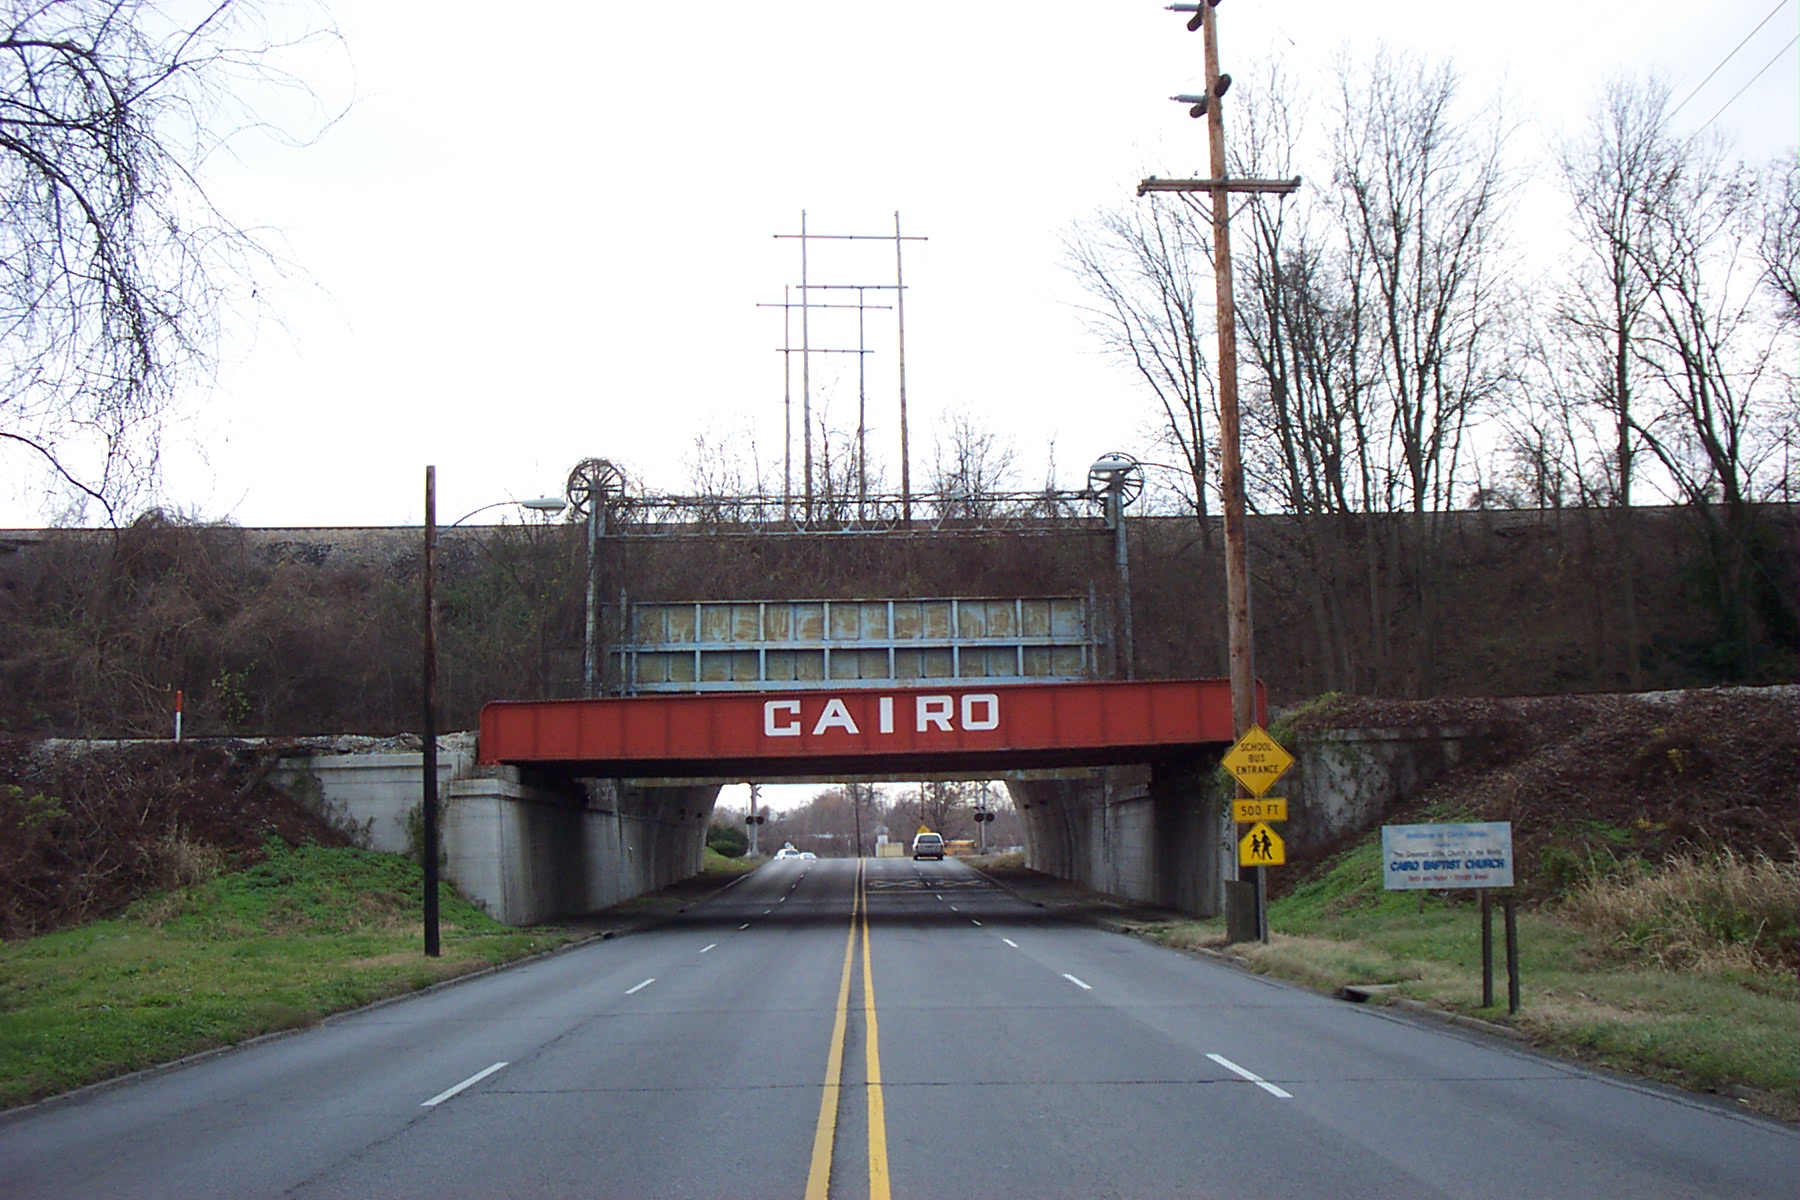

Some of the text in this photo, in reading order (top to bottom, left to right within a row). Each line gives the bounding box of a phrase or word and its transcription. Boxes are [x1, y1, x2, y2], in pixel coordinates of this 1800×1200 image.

[764, 693, 999, 737] CAIRO
[1240, 742, 1272, 752] SCHOOL
[1248, 754, 1265, 763] BUS
[1236, 765, 1279, 775] ENTRANCE
[1241, 804, 1279, 816] 500 FT
[1390, 858, 1505, 871] CAIRO BAPTIST CHURCH
